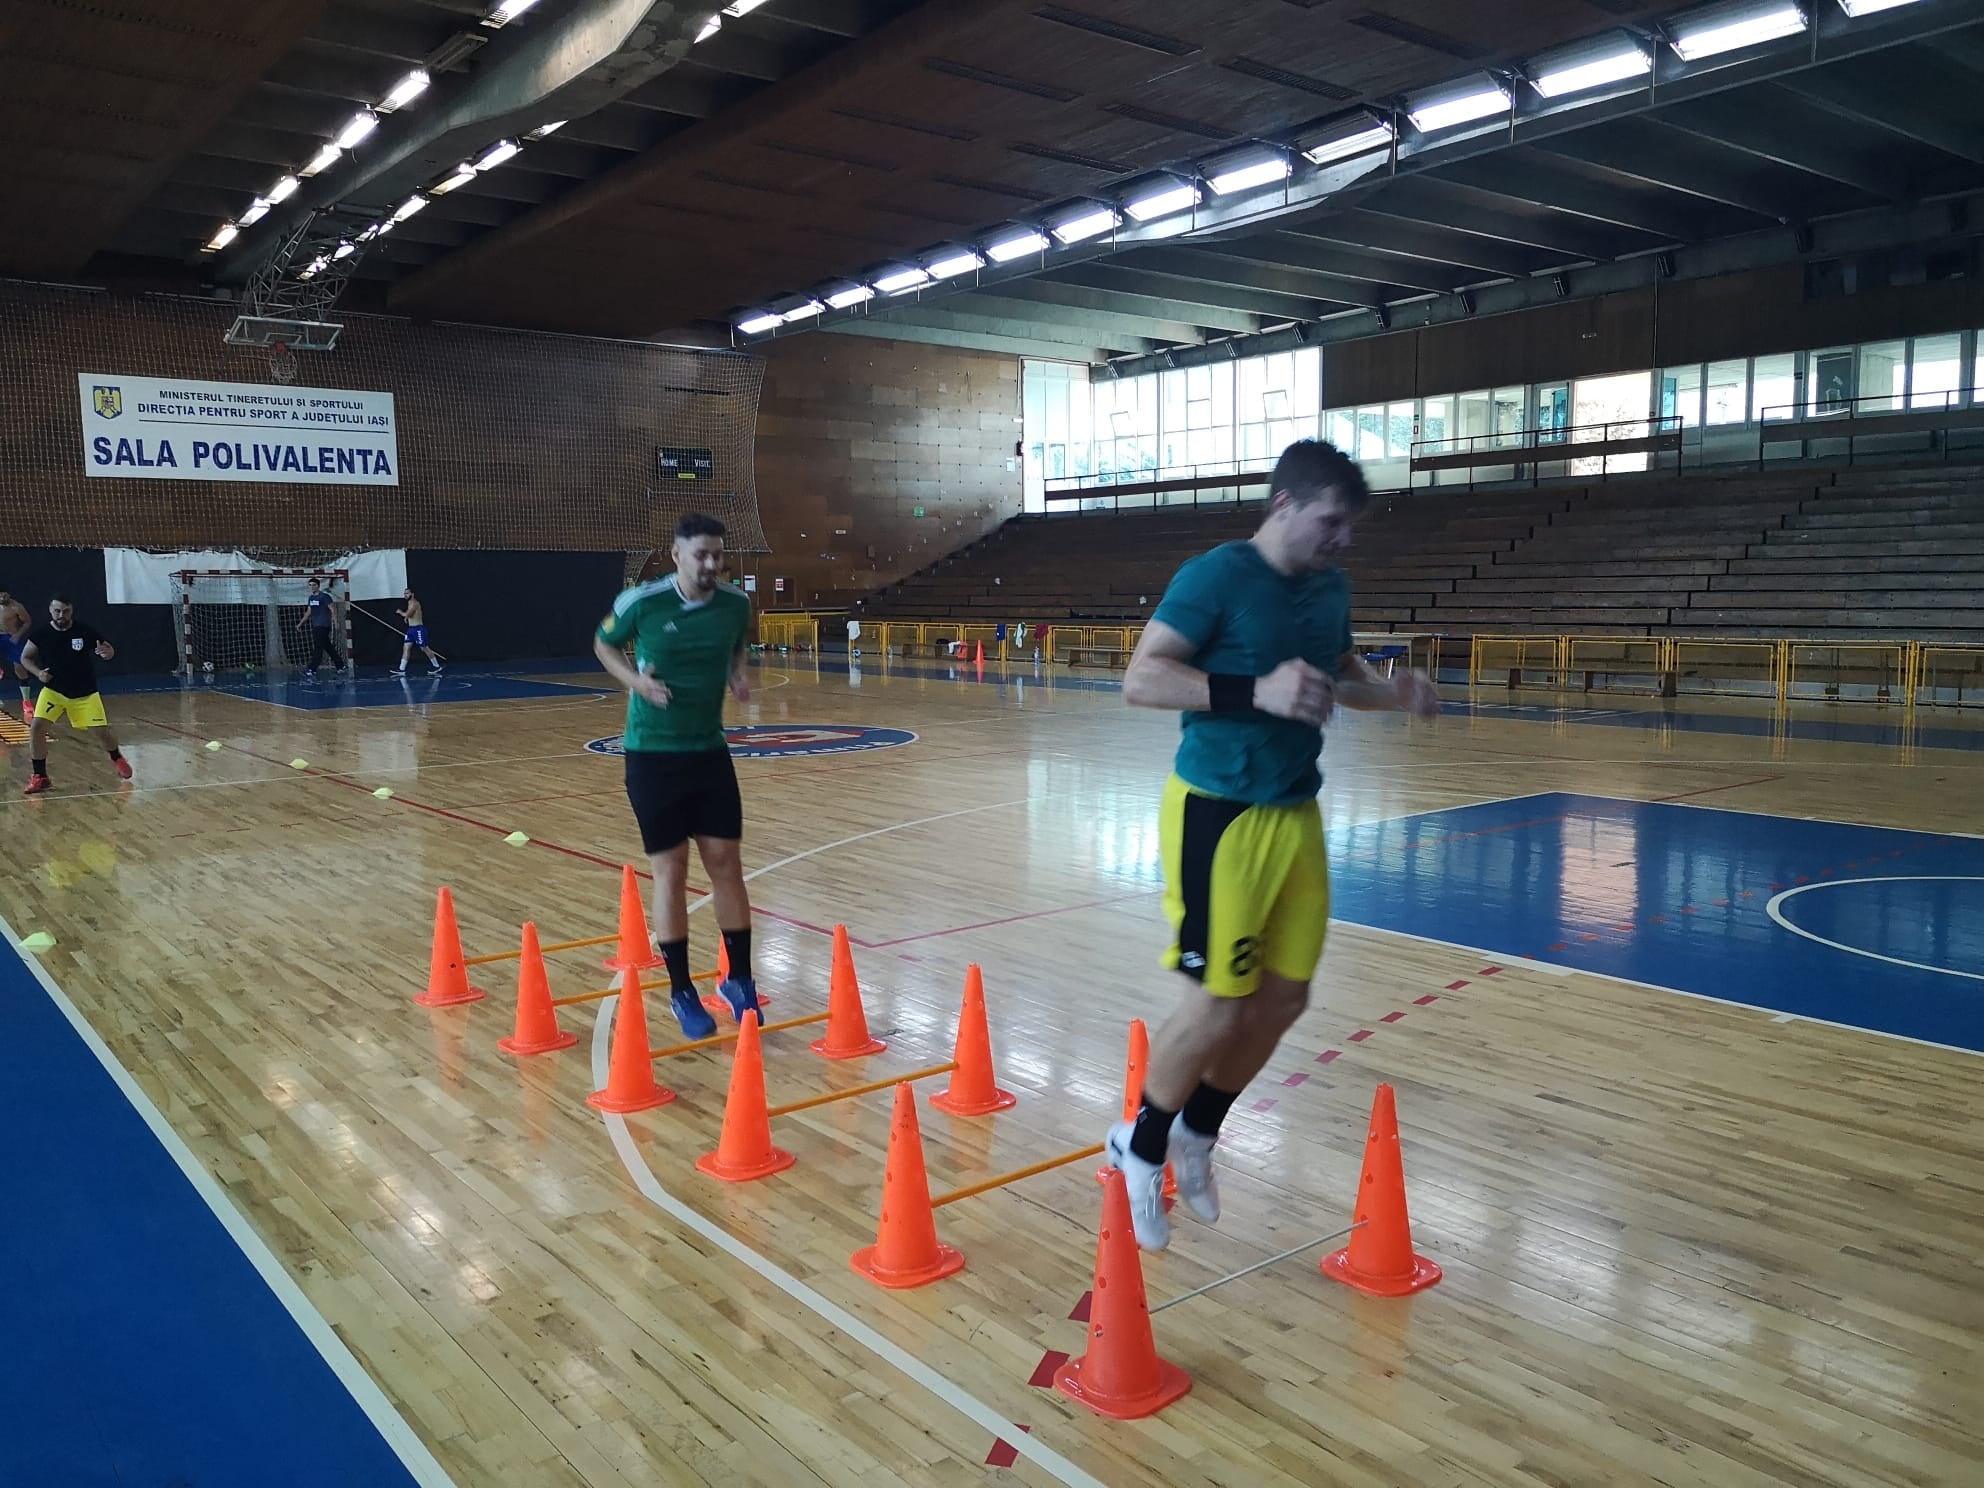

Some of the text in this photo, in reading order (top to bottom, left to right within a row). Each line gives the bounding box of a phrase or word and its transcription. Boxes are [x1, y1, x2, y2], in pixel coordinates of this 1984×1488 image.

[160, 390, 224, 403] MINISTERUL
[226, 394, 293, 406] TINERETULUI
[310, 399, 363, 410] SPORTULUI
[199, 406, 246, 418] PENTRU
[250, 408, 287, 420] SPORT
[291, 411, 300, 420] A
[93, 436, 392, 476] SALA POLIVALENTA
[46, 701, 55, 713] 7
[1231, 935, 1259, 978] 8
